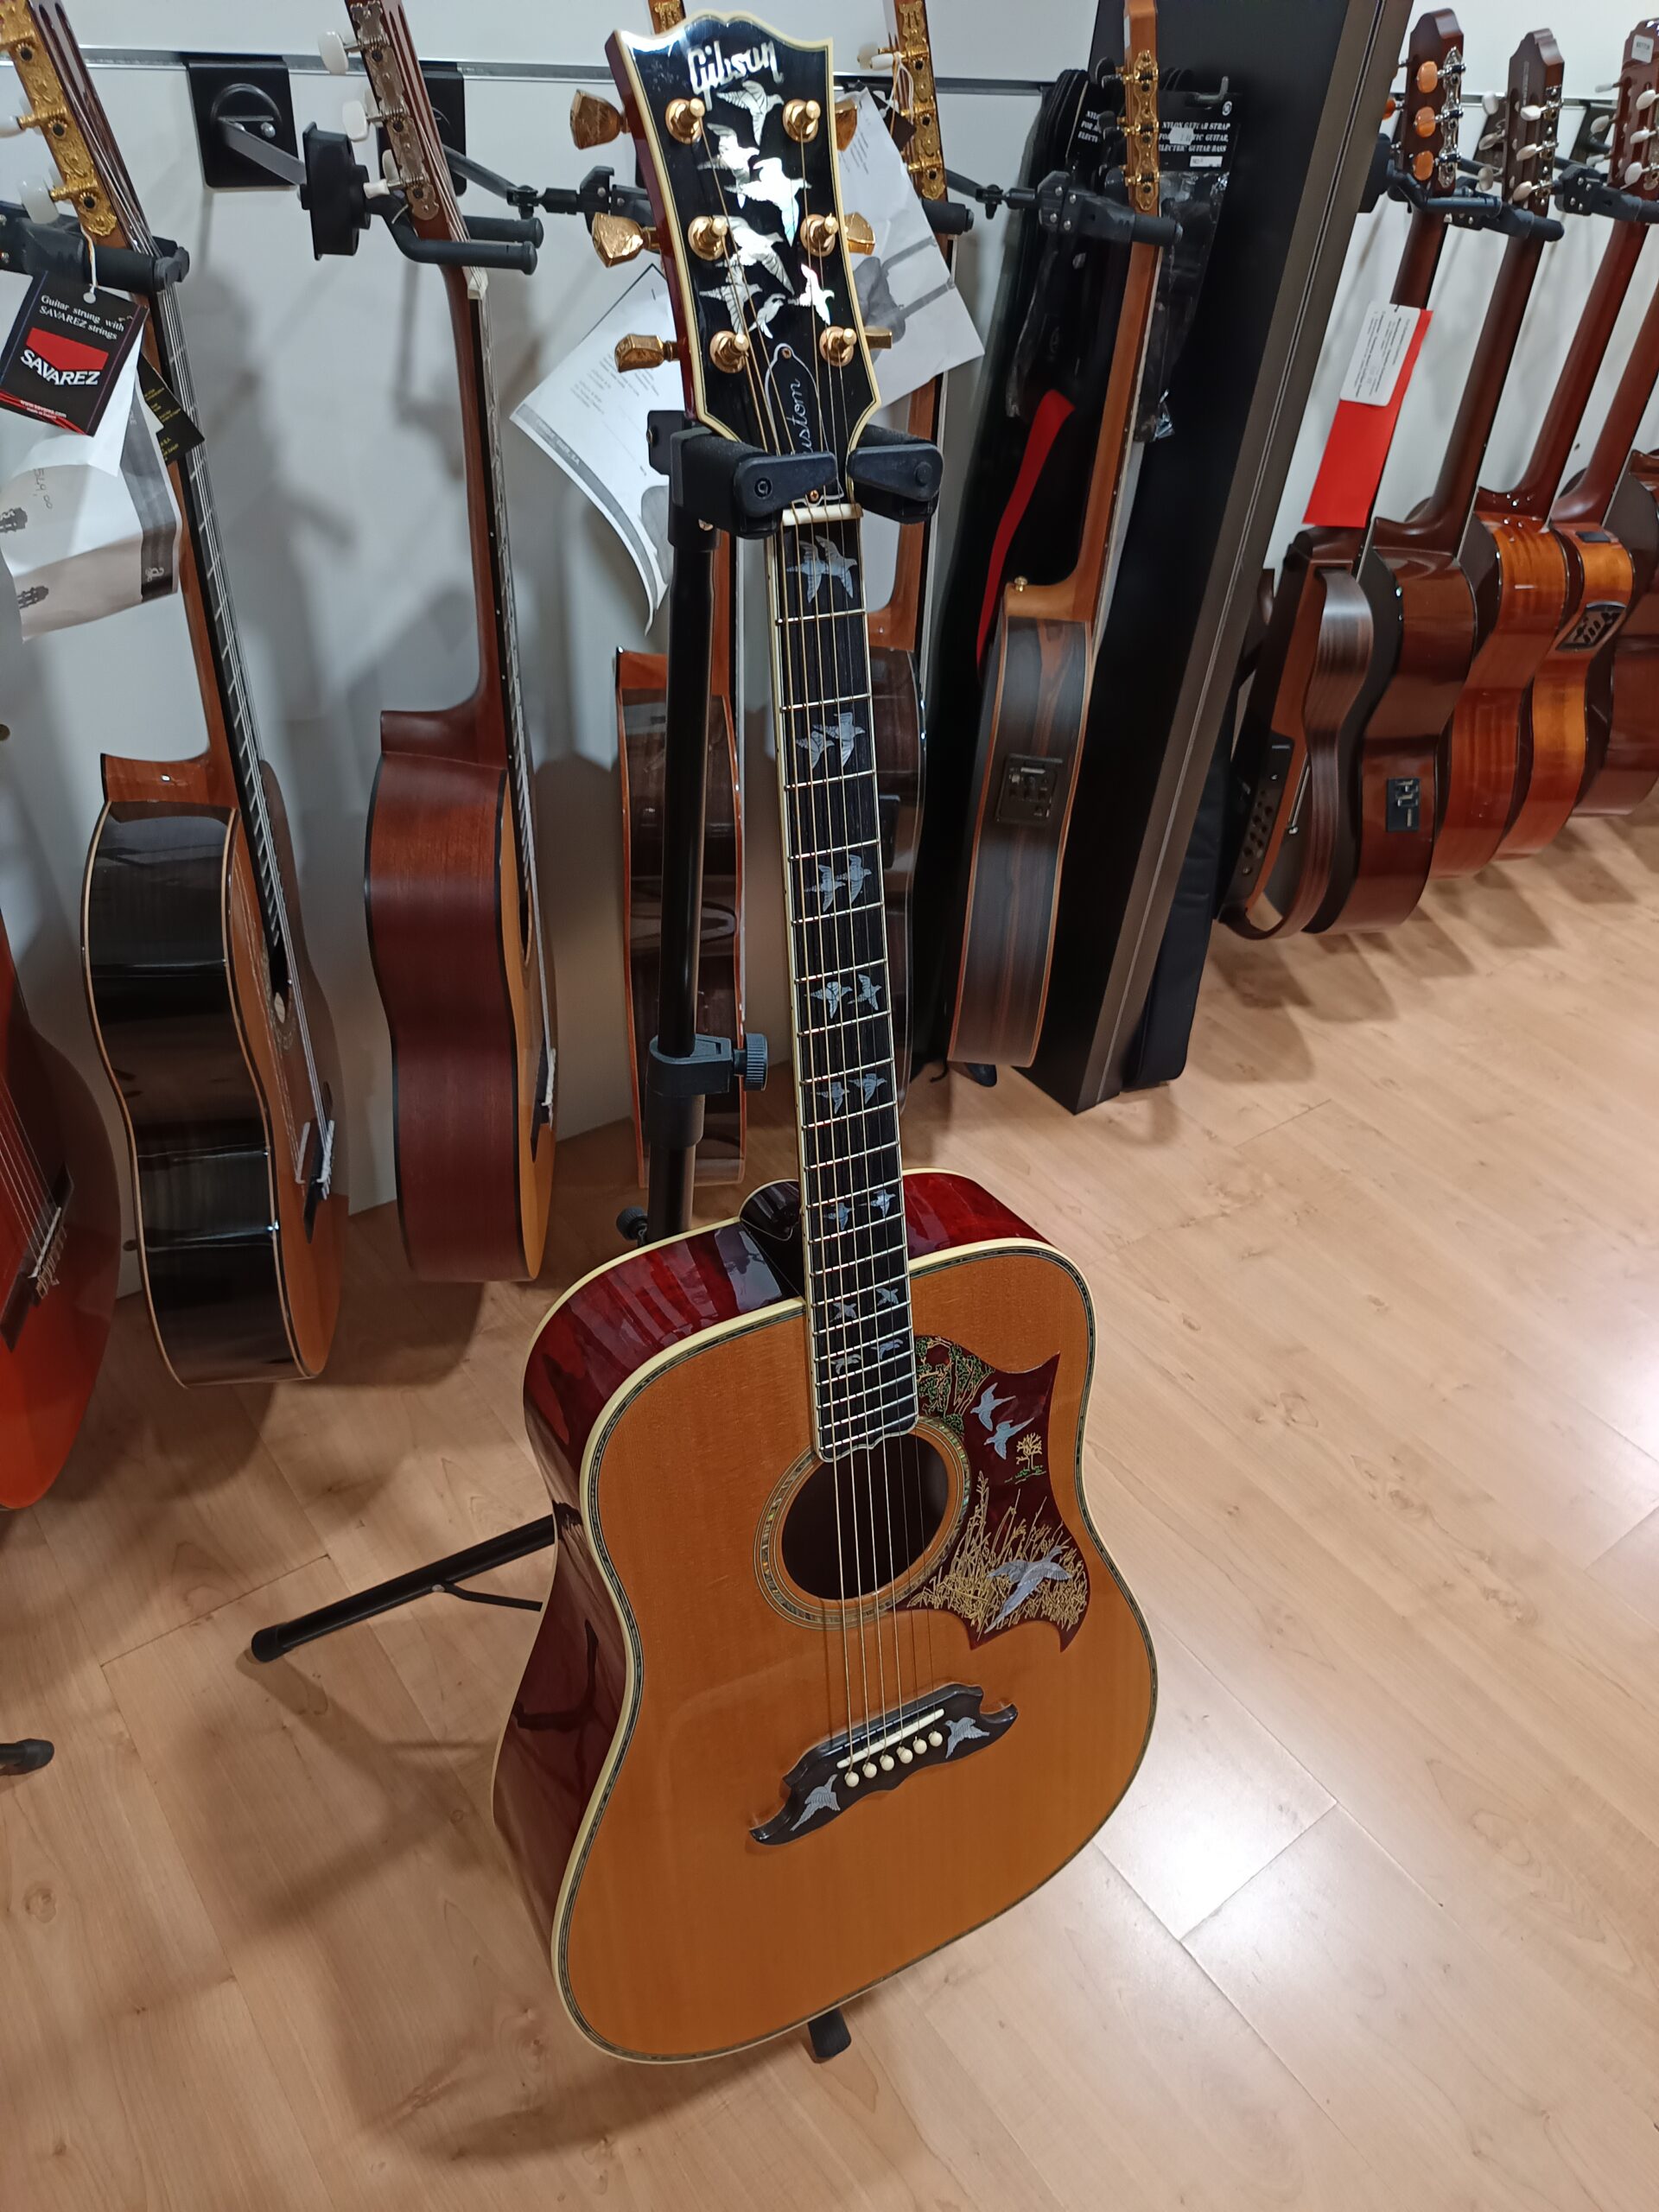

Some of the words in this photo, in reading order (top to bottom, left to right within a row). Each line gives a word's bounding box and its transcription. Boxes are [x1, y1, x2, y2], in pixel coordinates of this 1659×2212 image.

[688, 40, 784, 111] Gibson
[1211, 144, 1227, 153] BASS
[39, 305, 87, 328] SAVAREZ
[87, 323, 118, 340] strings
[41, 294, 70, 310] Guitar
[73, 308, 101, 324] strung
[105, 319, 124, 332] with
[20, 349, 101, 386] SAVAREZ
[786, 378, 814, 454] ustom
